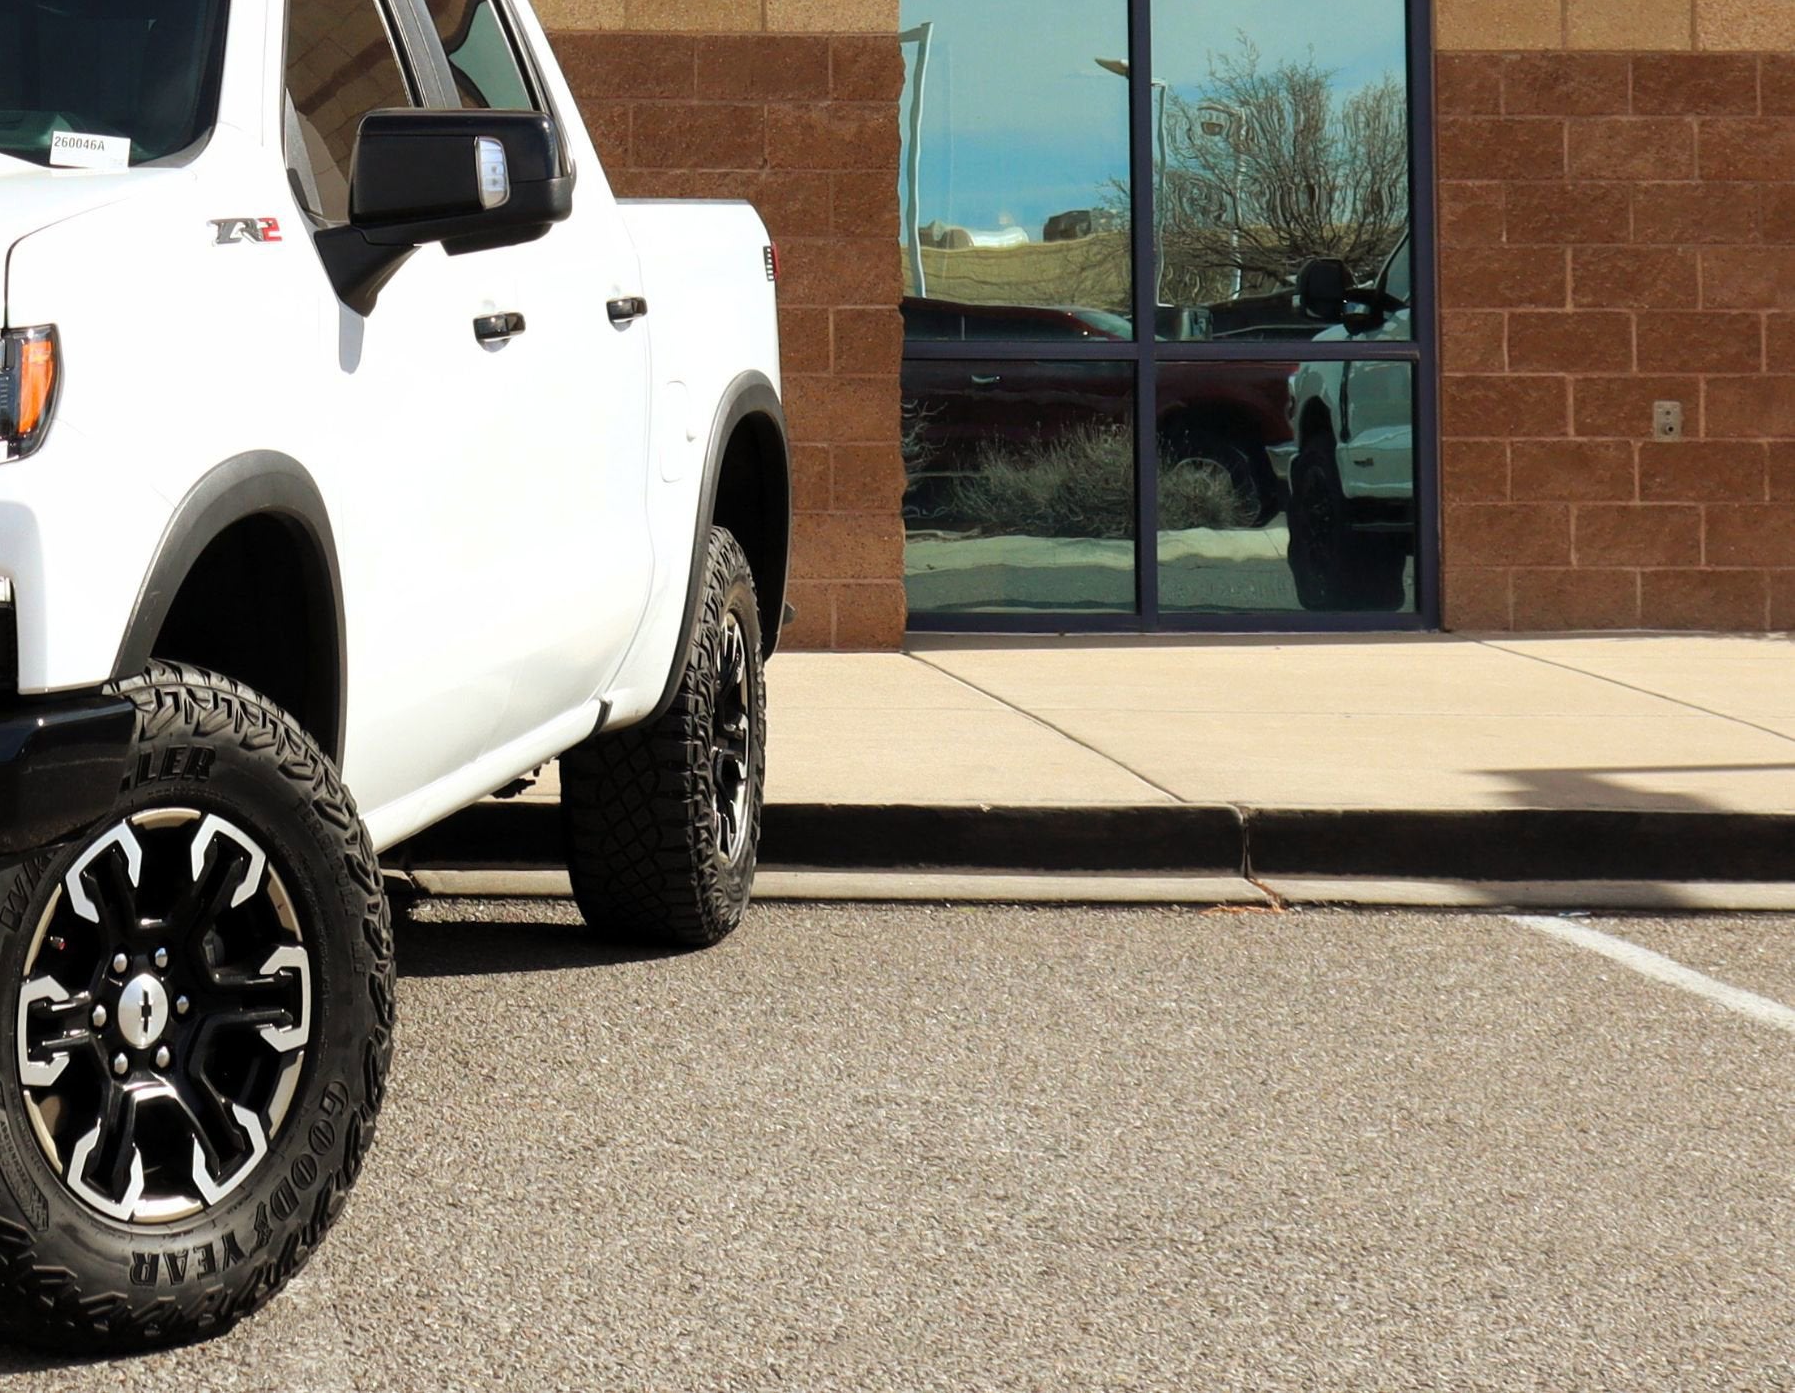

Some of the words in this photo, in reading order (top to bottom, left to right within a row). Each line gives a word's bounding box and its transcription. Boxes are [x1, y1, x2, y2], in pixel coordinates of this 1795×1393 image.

[53, 135, 106, 152] 260046A
[207, 217, 283, 245] ZR2
[129, 1079, 351, 1288] GOODYEAR
